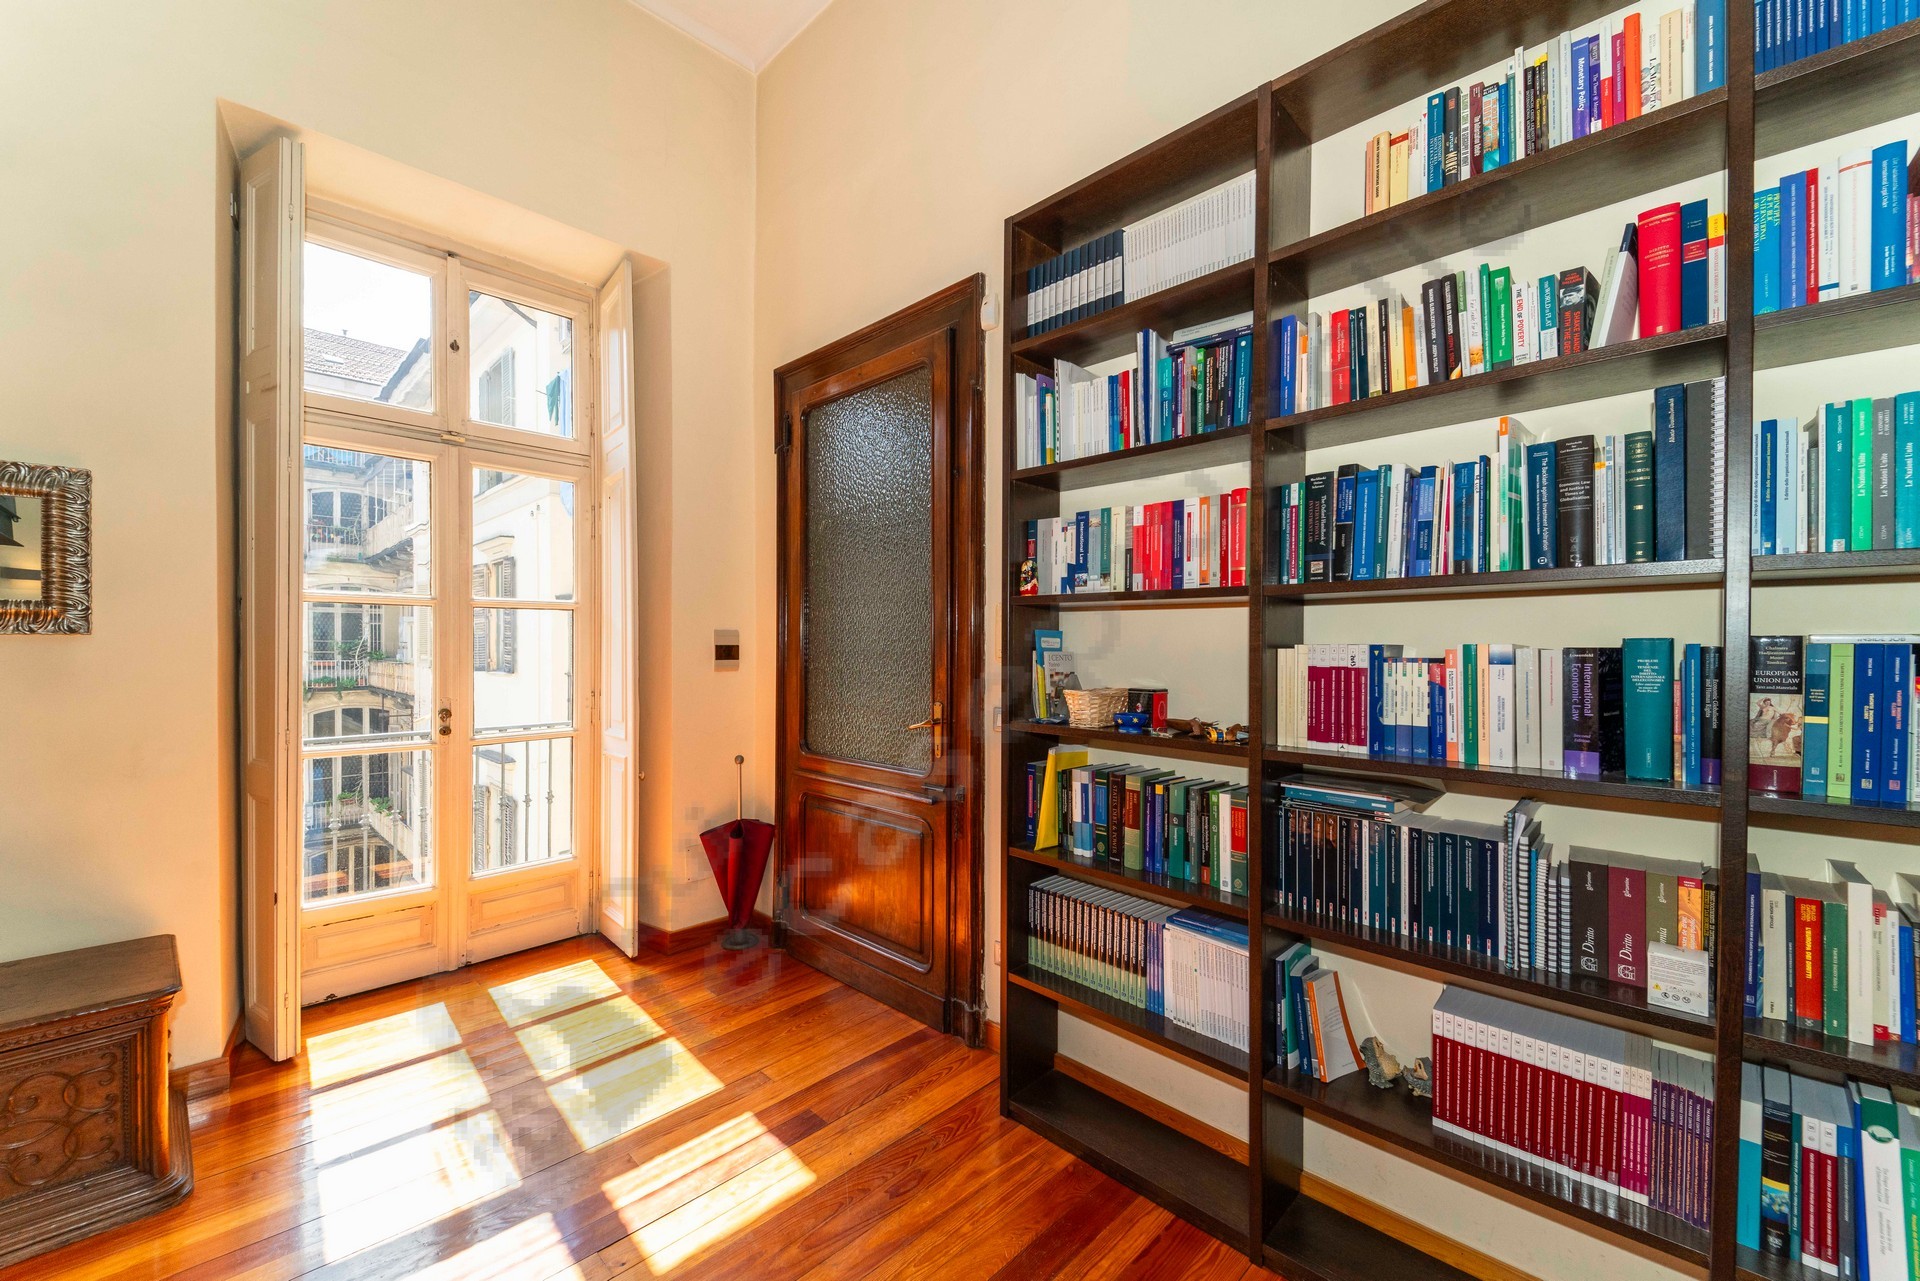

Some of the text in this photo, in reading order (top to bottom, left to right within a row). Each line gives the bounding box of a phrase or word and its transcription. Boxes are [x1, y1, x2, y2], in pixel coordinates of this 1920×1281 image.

[1649, 58, 1656, 71] LA
[1577, 57, 1586, 111] Monetary Policy
[1446, 151, 1457, 175] MONEY
[1858, 453, 1866, 467] Unite
[1879, 453, 1888, 467] Unite
[1904, 442, 1913, 457] Unite
[1858, 468, 1866, 488] Nazioni
[1879, 468, 1888, 489] Nazioni
[1904, 458, 1913, 479] Nazioni
[1570, 664, 1581, 721] Economic Law
[1583, 664, 1593, 716] International
[1582, 927, 1594, 953] Diritto
[1619, 933, 1632, 961] Diritto
